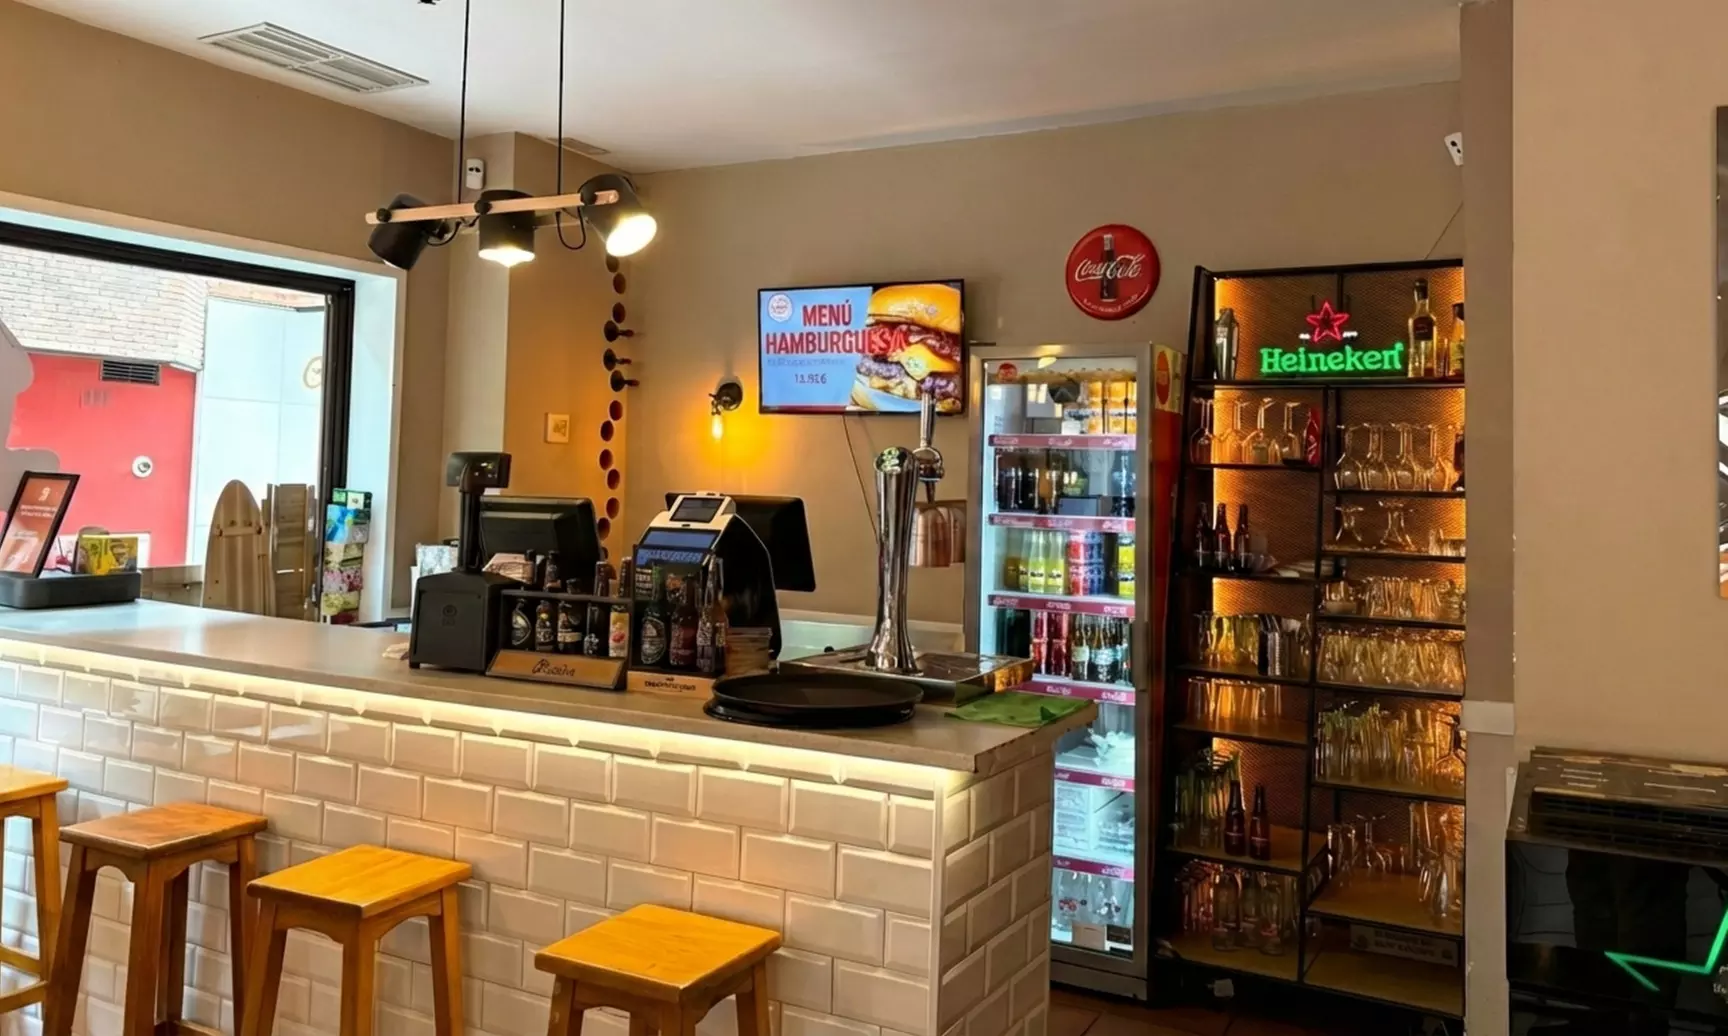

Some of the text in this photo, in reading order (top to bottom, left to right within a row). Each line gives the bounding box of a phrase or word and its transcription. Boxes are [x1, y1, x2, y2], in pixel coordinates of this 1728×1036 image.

[803, 300, 853, 327] MENÚ
[765, 328, 909, 356] HAMBURGUESA
[1259, 342, 1404, 374] Heineken
